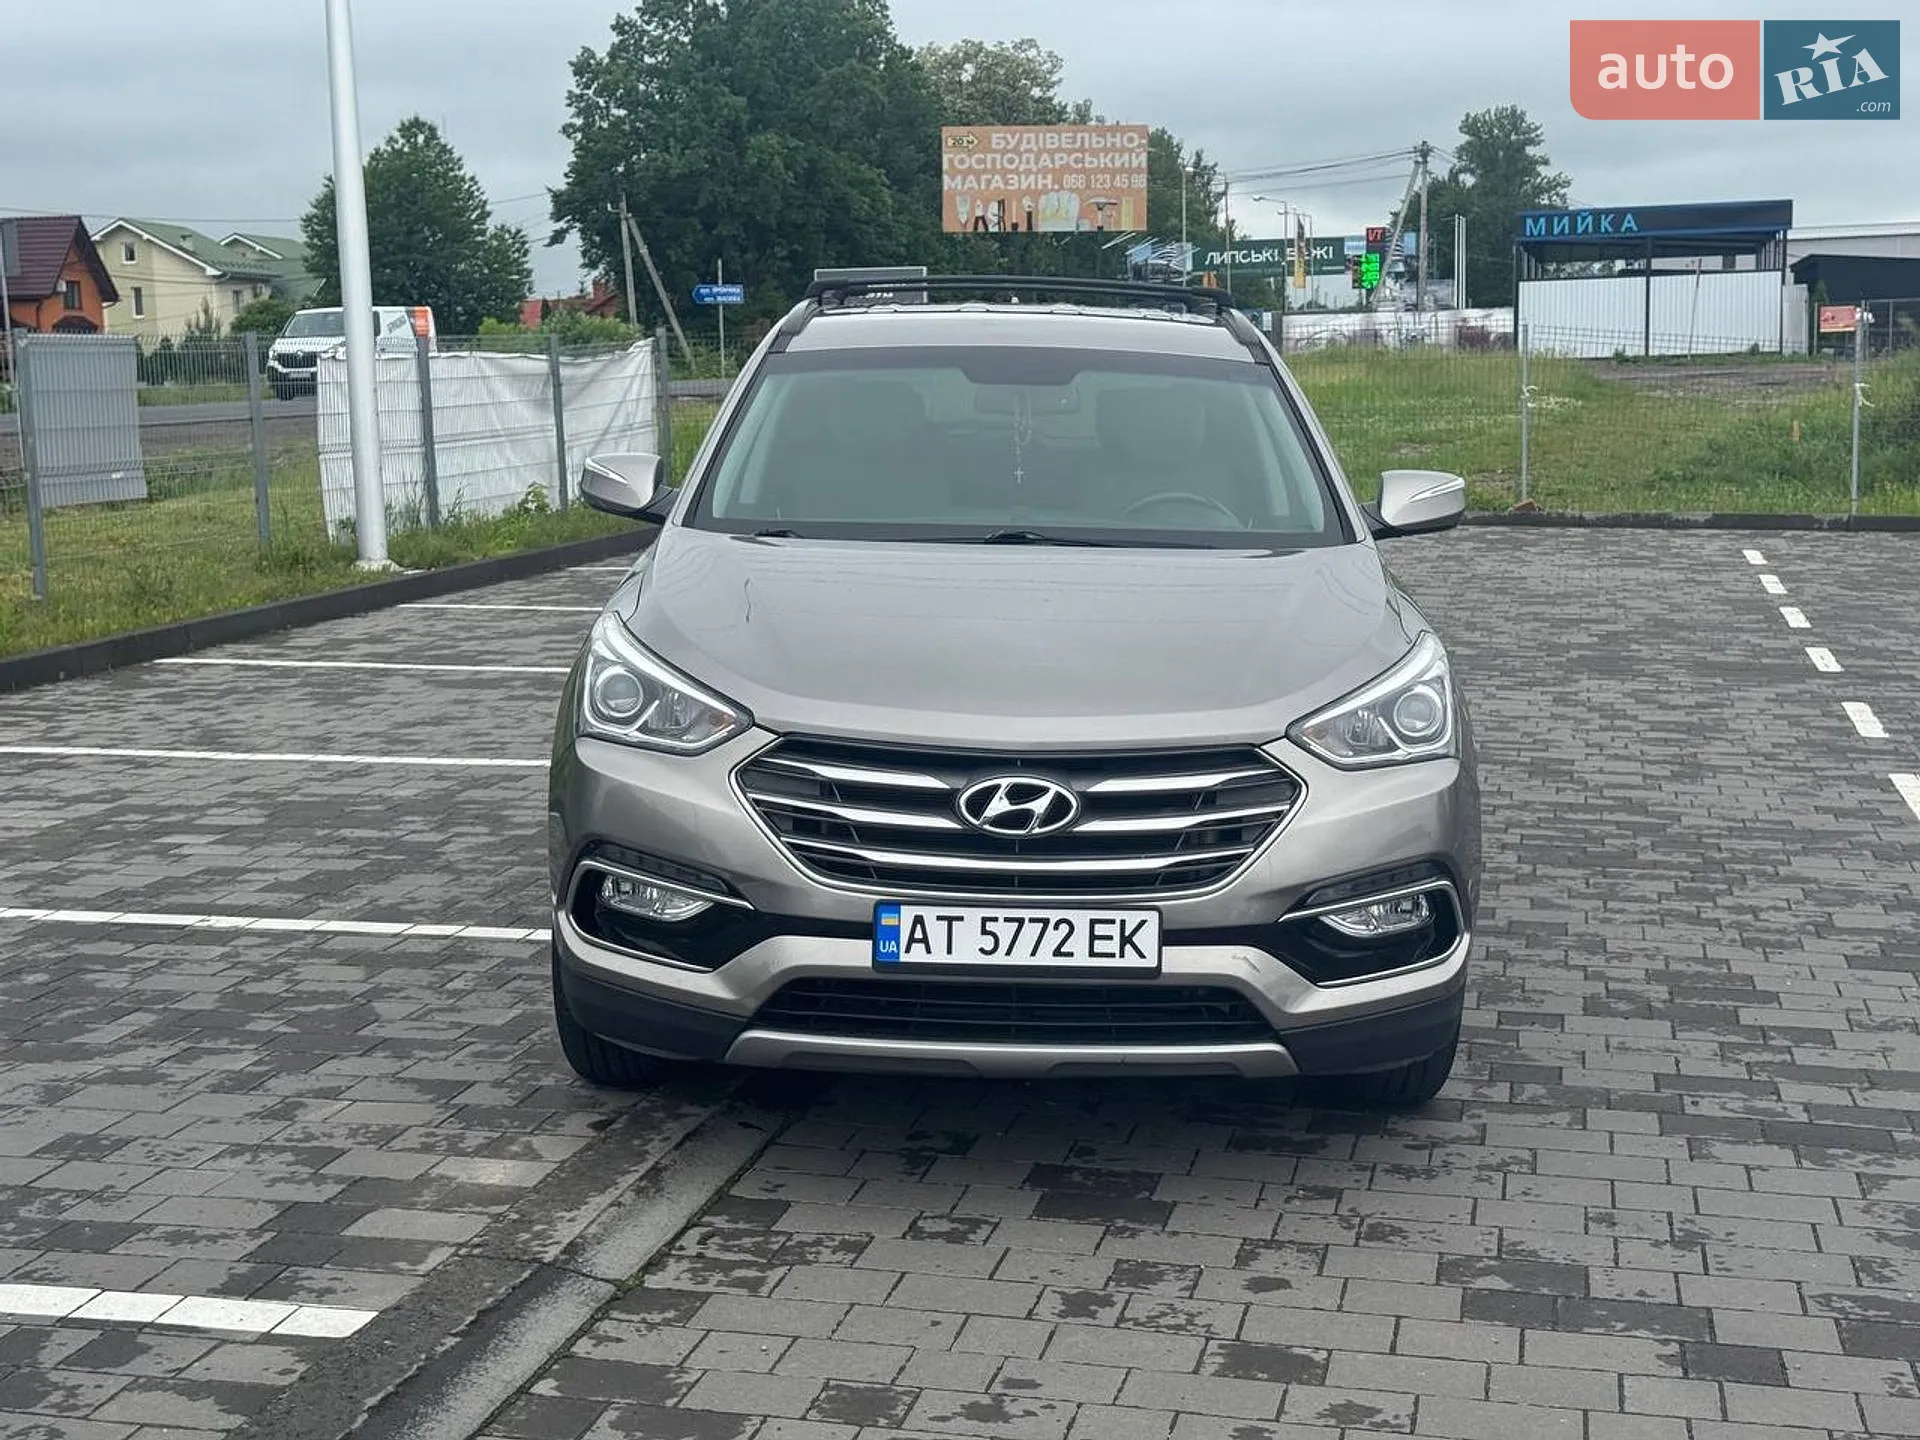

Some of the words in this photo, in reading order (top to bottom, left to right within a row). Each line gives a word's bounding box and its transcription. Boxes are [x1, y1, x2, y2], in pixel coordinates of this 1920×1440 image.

[991, 132, 1147, 150] БУДІВЕЛЬНО-
[943, 151, 1147, 171] ГОСПОДАРСЬКИЙ
[944, 174, 1059, 190] МАГАЗИН.
[1090, 174, 1111, 189] 123
[1525, 212, 1639, 237] МИЙКА
[1205, 249, 1278, 265] ЛИПСЬКІ
[904, 914, 965, 955] AT
[978, 916, 1075, 958] 5772
[1088, 918, 1148, 959] EK
[879, 940, 898, 953] UA
